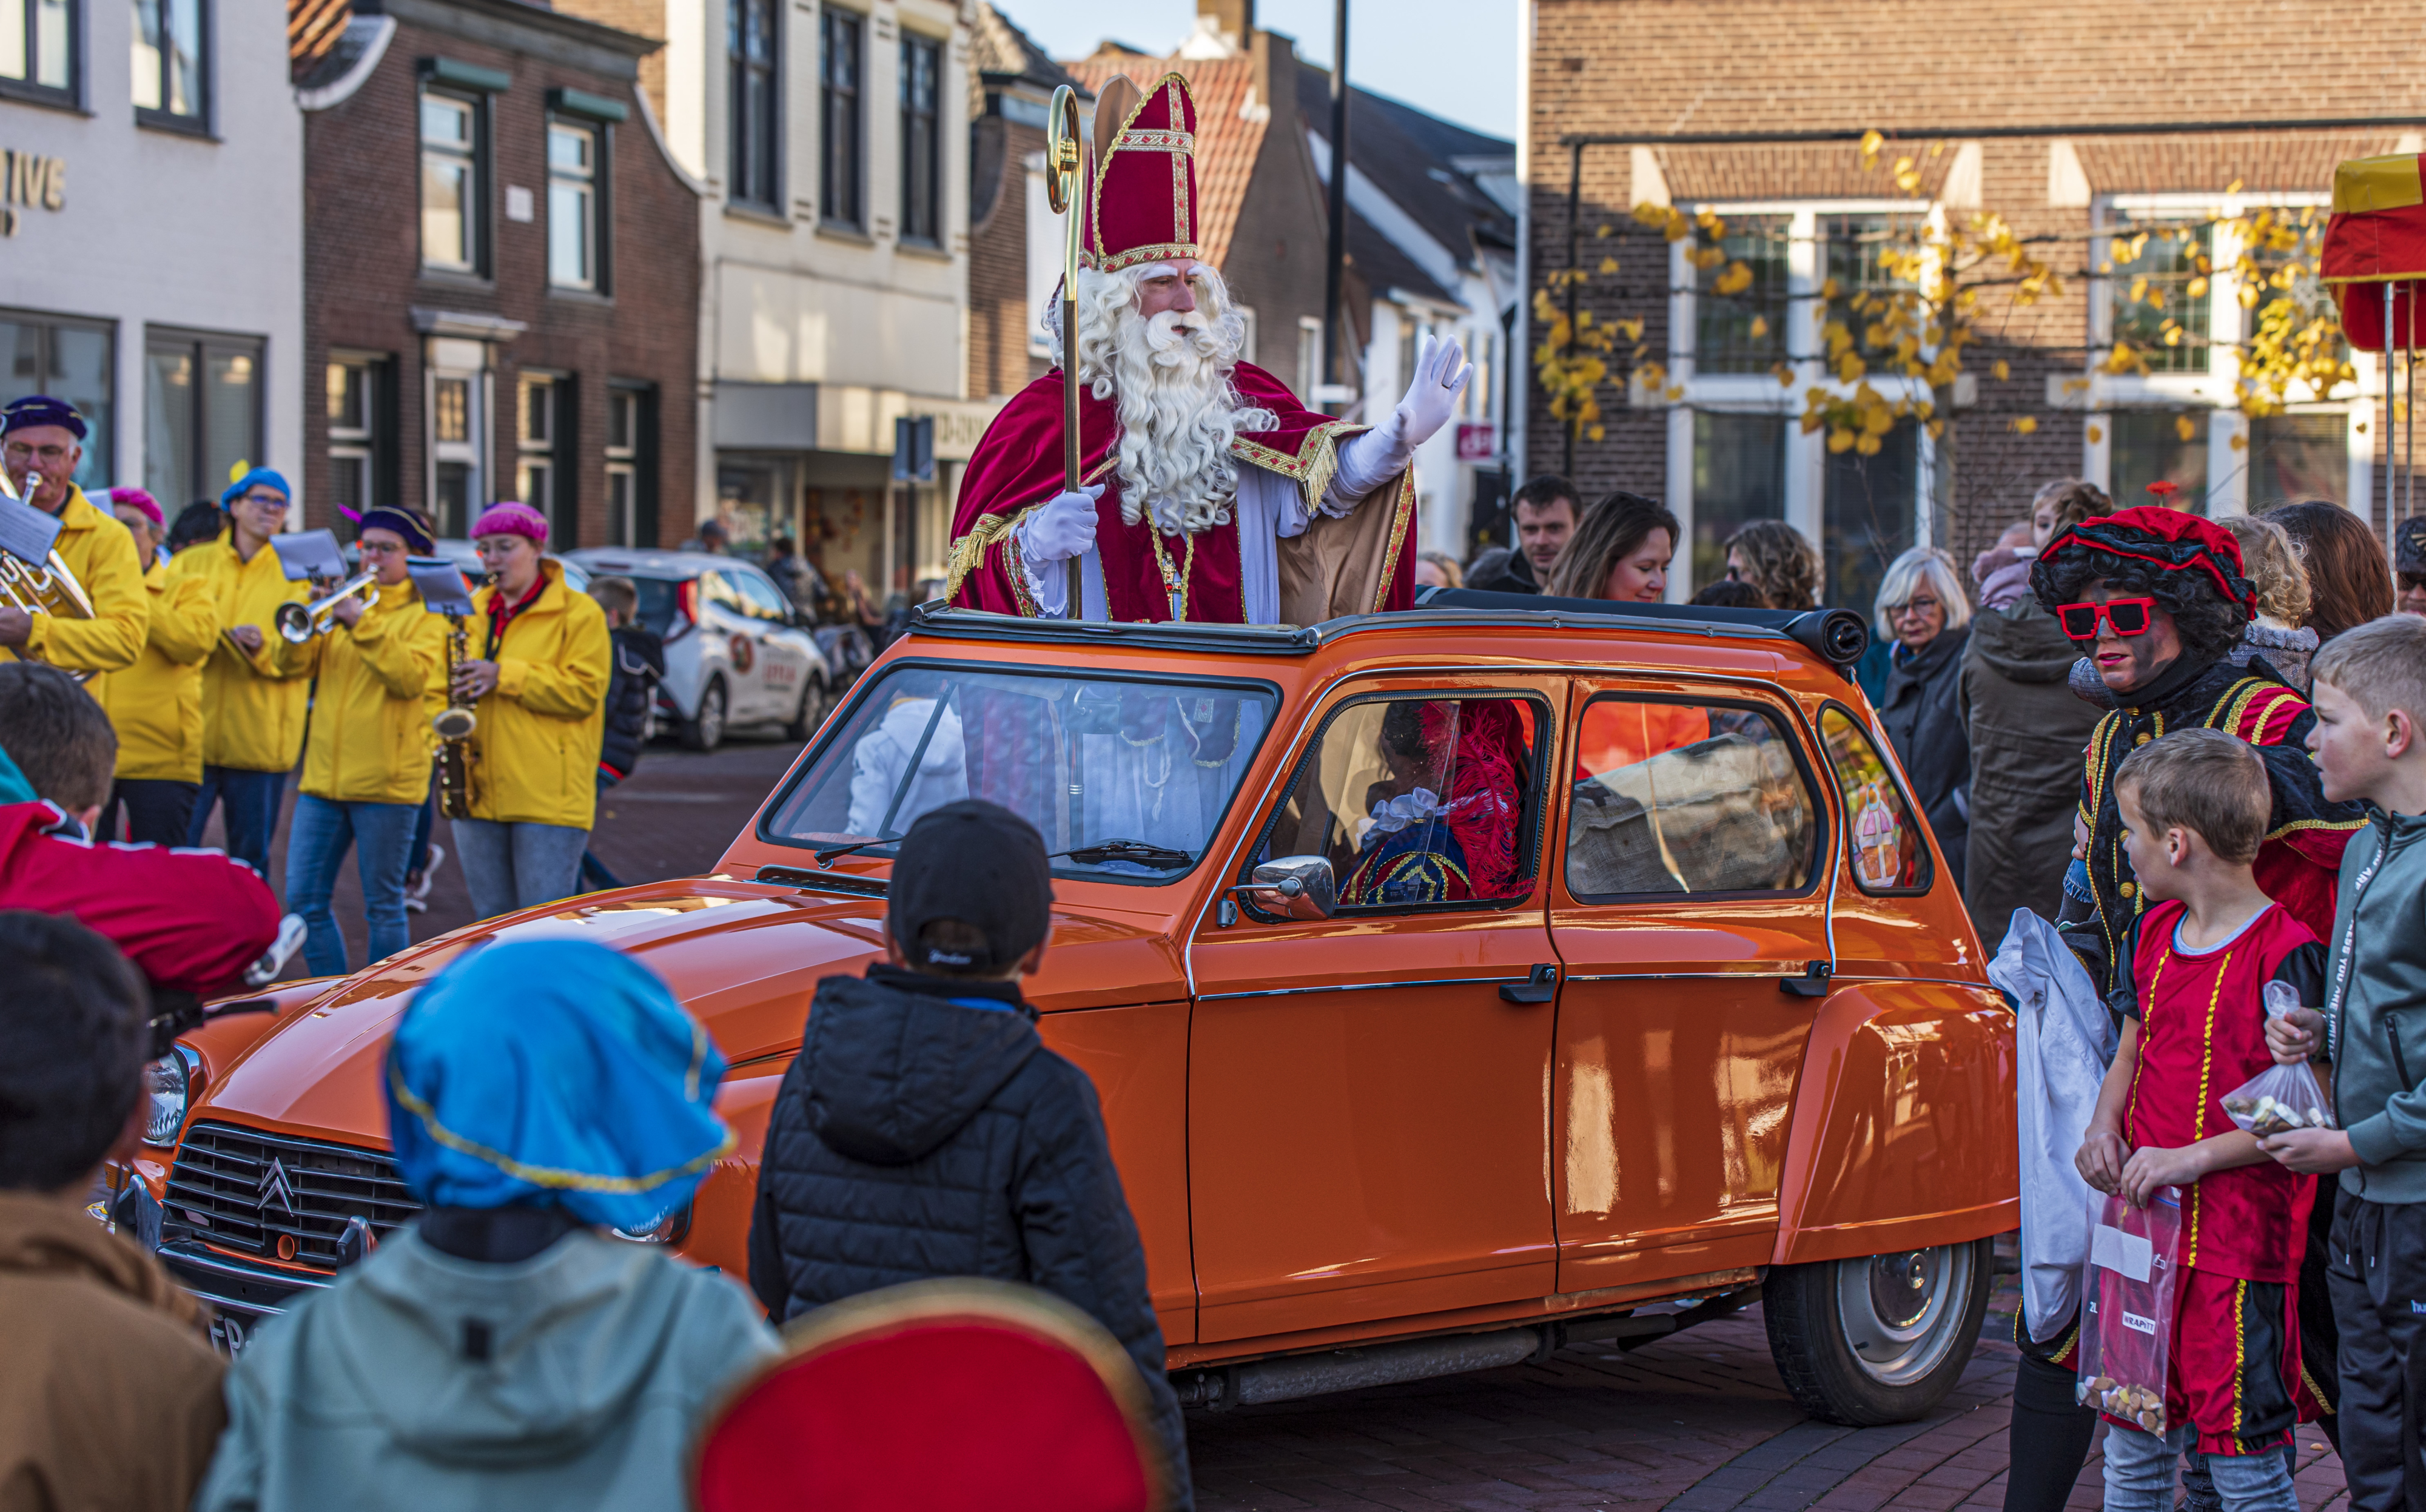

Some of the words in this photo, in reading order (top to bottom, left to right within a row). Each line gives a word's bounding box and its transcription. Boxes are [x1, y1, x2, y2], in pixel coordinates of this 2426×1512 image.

[2336, 958, 2348, 983] YOU
[2328, 985, 2341, 1011] ARE
[2089, 1301, 2098, 1314] 2L
